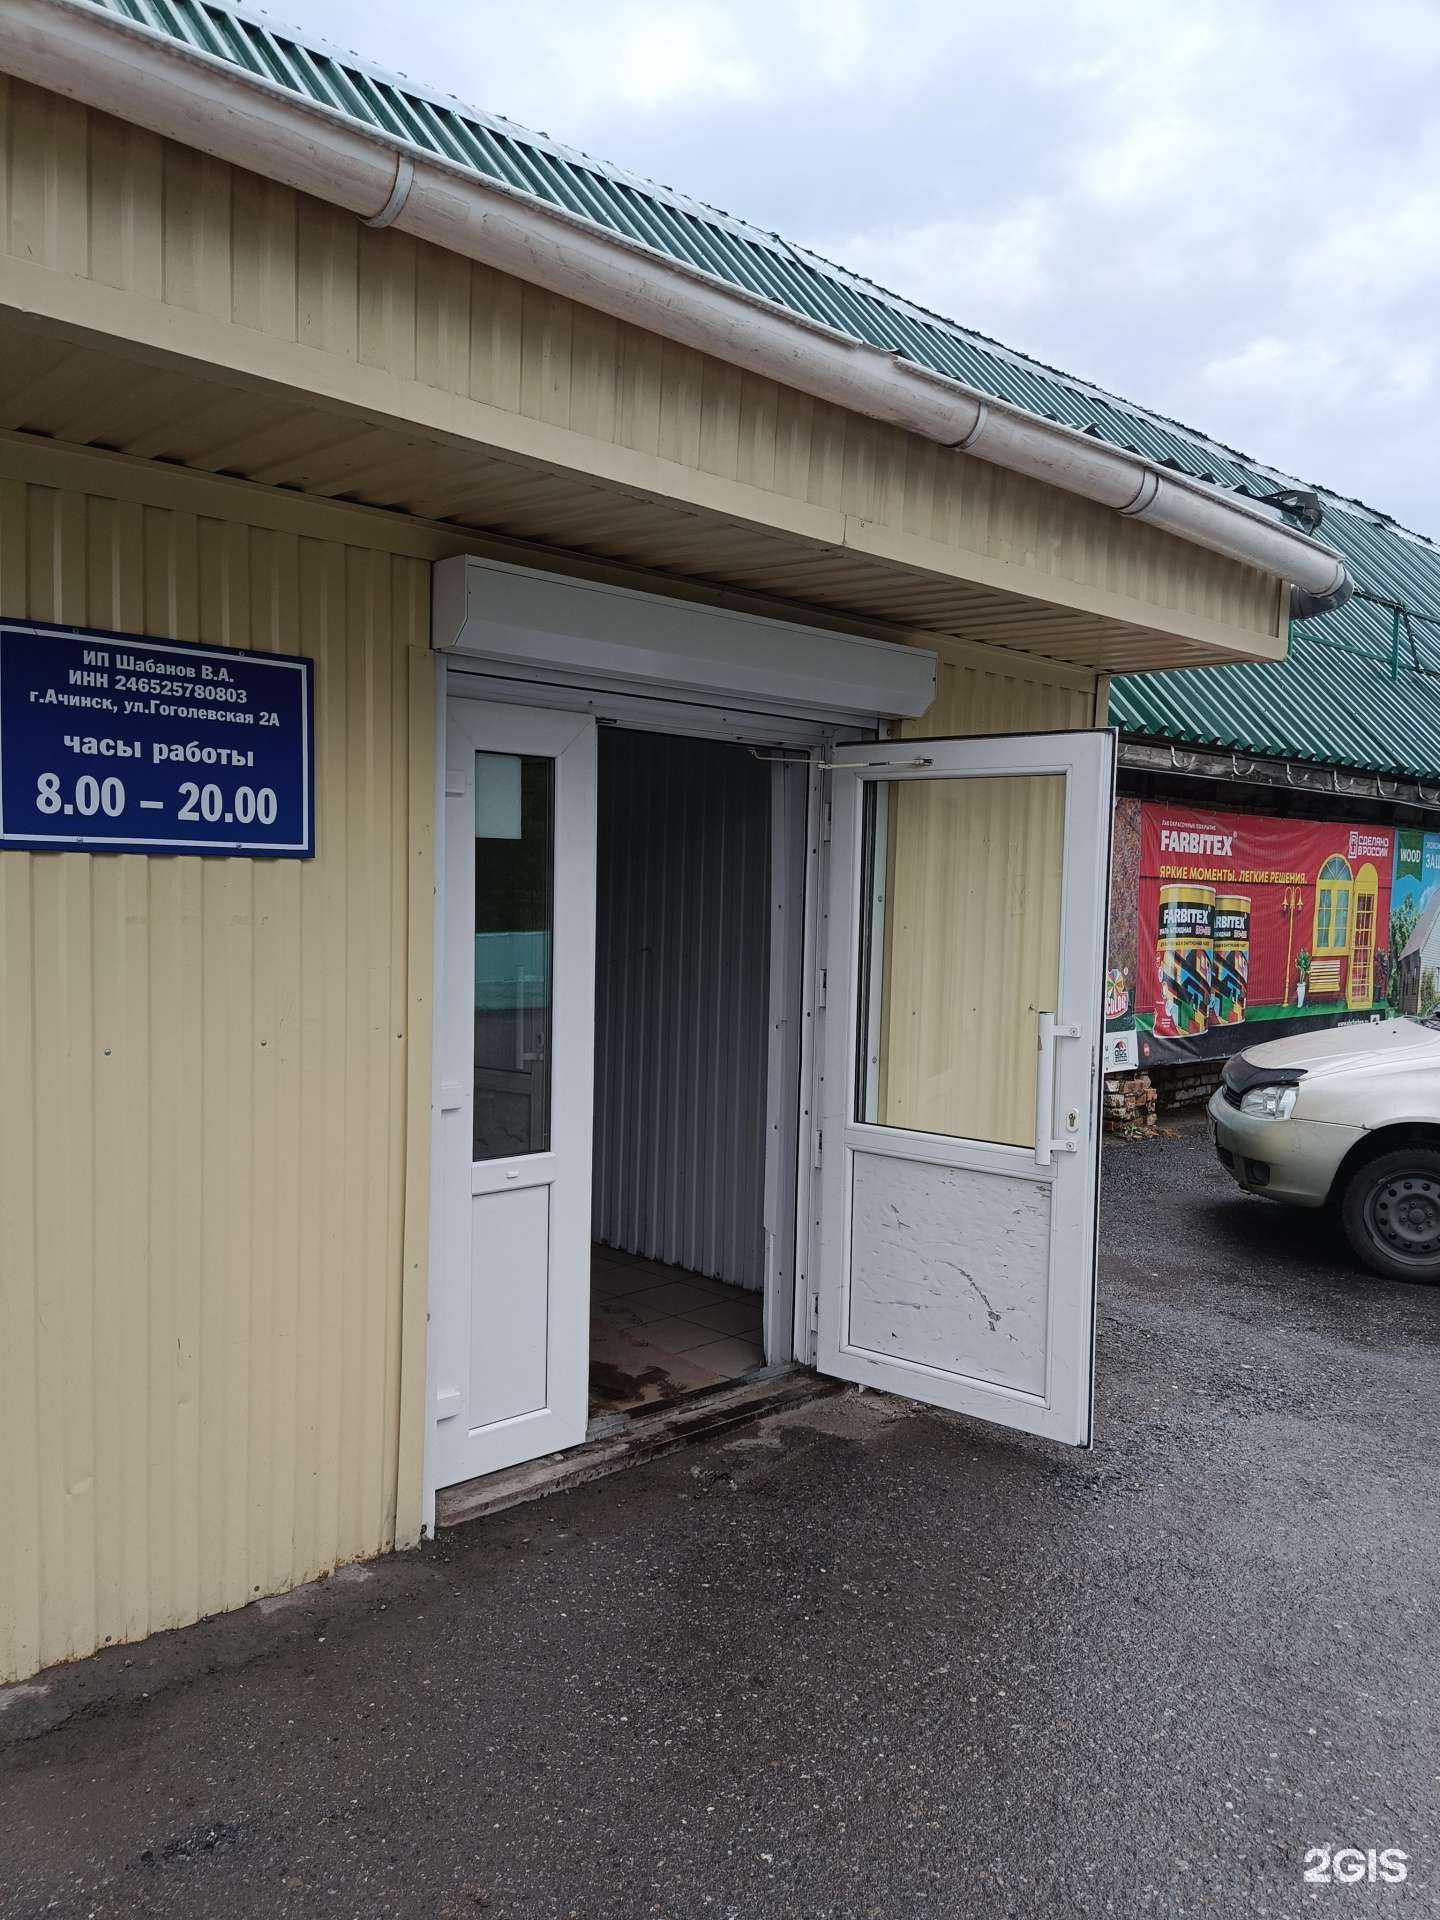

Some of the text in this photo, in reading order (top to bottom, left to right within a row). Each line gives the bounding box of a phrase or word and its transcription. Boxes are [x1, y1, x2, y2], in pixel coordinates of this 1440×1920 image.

[83, 650, 235, 682] ИП Шабанов В.А.
[69, 670, 248, 704] ИНН 246525780803
[29, 688, 280, 726] г.Ачинск, ул.Гоголевская 2А
[63, 735, 254, 767] часы работы
[35, 772, 126, 817] 8.00
[177, 781, 278, 825] 20.00
[1160, 829, 1233, 857] FARBITEX
[1400, 848, 1421, 863] WOOD
[1160, 865, 1308, 884] ЯРКИЕ МОМЕНТЫ. ЛЕГКИЕ РЕШЕНИЯ.
[1163, 909, 1209, 924] FARBITEX
[1215, 916, 1245, 929] RBITEX
